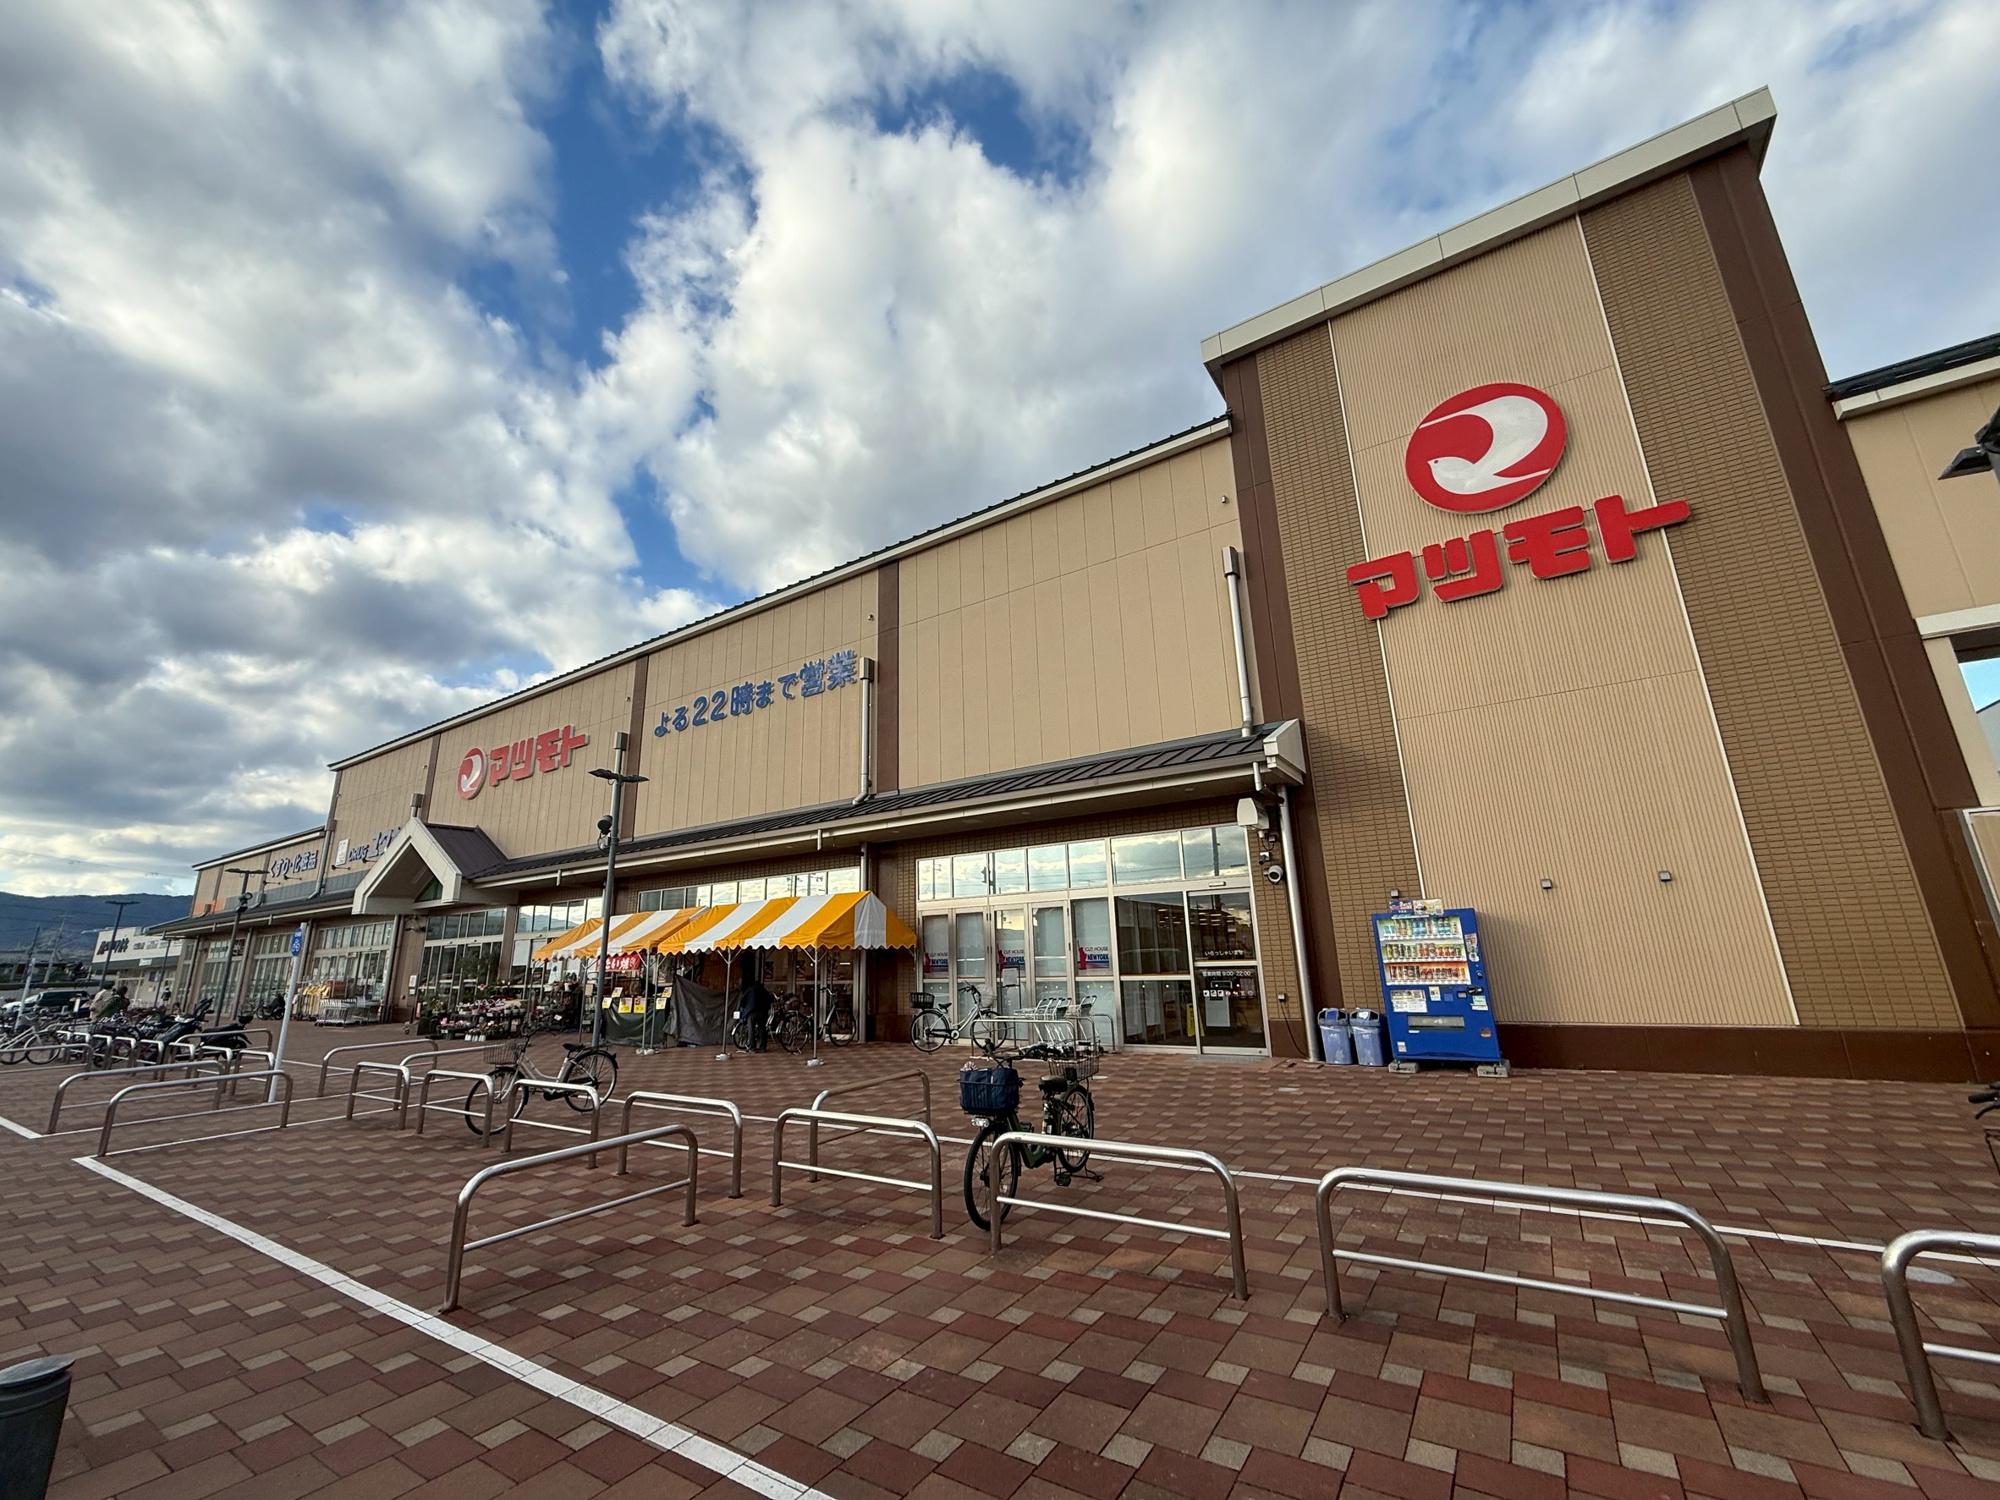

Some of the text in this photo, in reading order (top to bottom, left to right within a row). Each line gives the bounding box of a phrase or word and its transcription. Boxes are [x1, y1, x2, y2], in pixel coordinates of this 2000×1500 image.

[1347, 494, 1691, 620] マツモト
[654, 650, 857, 738] よる22時まで営業
[489, 724, 589, 787] マツモト
[348, 845, 369, 861] DRUG
